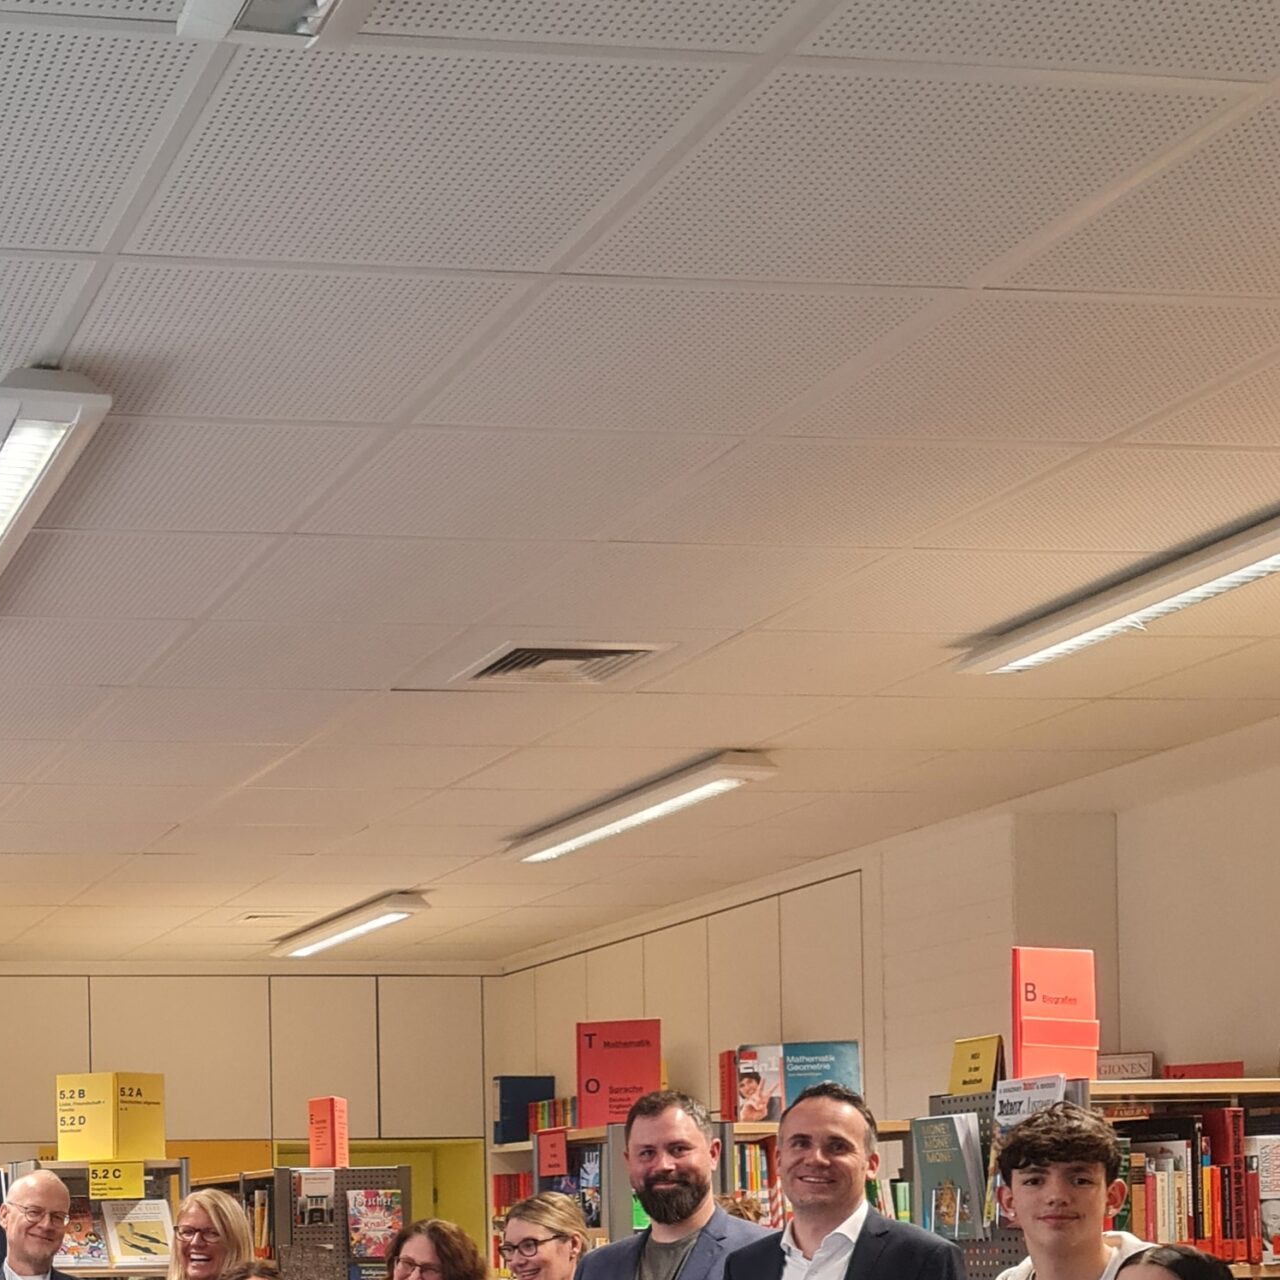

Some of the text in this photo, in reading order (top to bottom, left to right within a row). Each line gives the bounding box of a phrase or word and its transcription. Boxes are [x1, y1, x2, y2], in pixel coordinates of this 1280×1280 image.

[1024, 982, 1037, 1002] B
[583, 1033, 597, 1049] T
[786, 1055, 836, 1064] Mathematik
[786, 1063, 832, 1072] Geometrie
[1099, 1063, 1149, 1076] GIONEN
[585, 1078, 600, 1094] O
[59, 1088, 86, 1100] 5.2 B
[120, 1087, 143, 1098] 5.2 A
[59, 1115, 86, 1127] 5.2 D
[91, 1168, 122, 1180] 5.2 C
